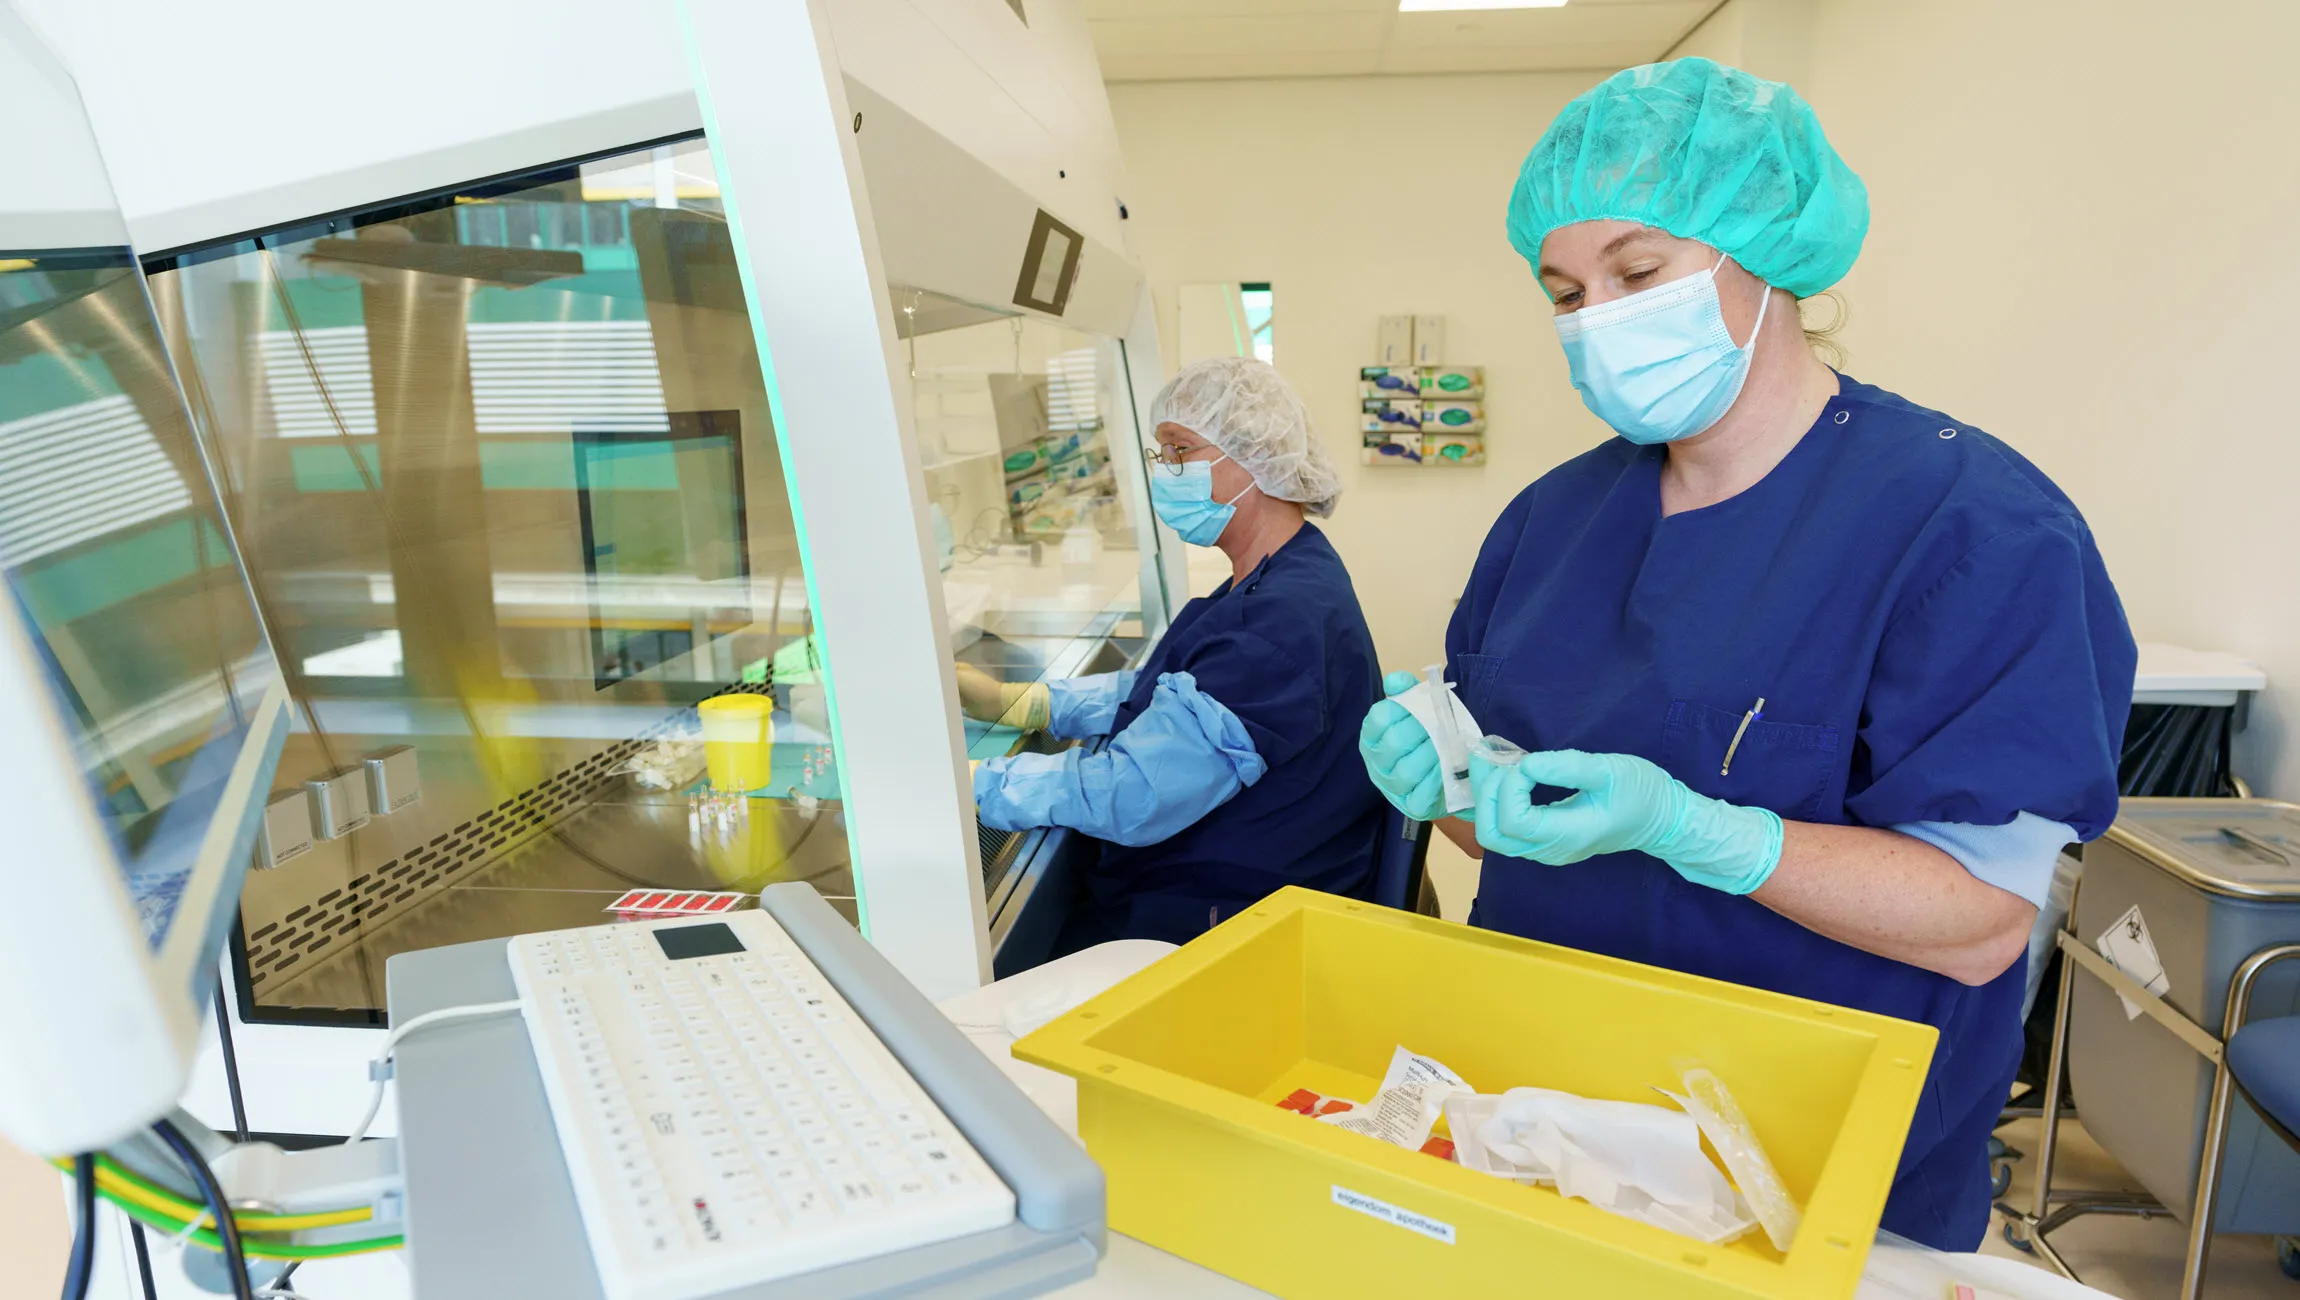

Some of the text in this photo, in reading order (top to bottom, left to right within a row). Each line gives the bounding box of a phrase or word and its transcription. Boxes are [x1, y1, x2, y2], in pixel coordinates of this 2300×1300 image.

[285, 841, 308, 855] CONNECTED
[1338, 1193, 1447, 1235] eigendom apotheek
